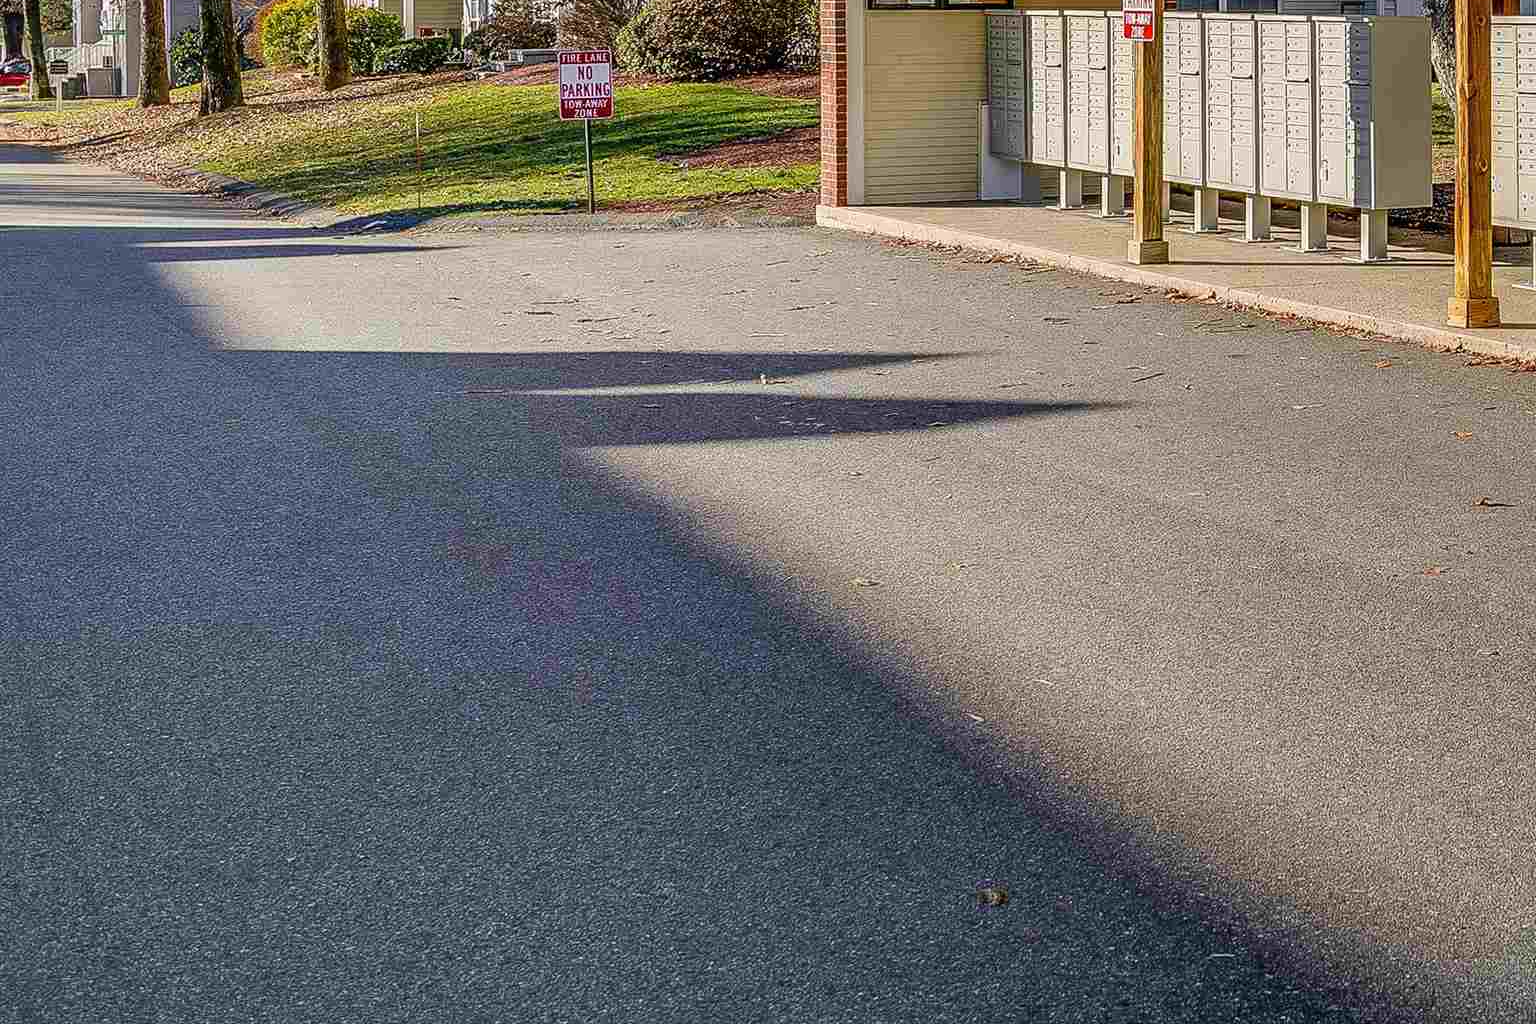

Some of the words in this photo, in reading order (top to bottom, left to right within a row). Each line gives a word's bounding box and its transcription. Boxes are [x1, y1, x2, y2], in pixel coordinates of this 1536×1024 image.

[562, 53, 582, 63] FIRE
[585, 53, 609, 62] LANE
[578, 65, 593, 81] NO
[562, 82, 610, 97] PARKING
[563, 98, 608, 109] TOW-AWAY
[575, 109, 599, 118] ZONE
